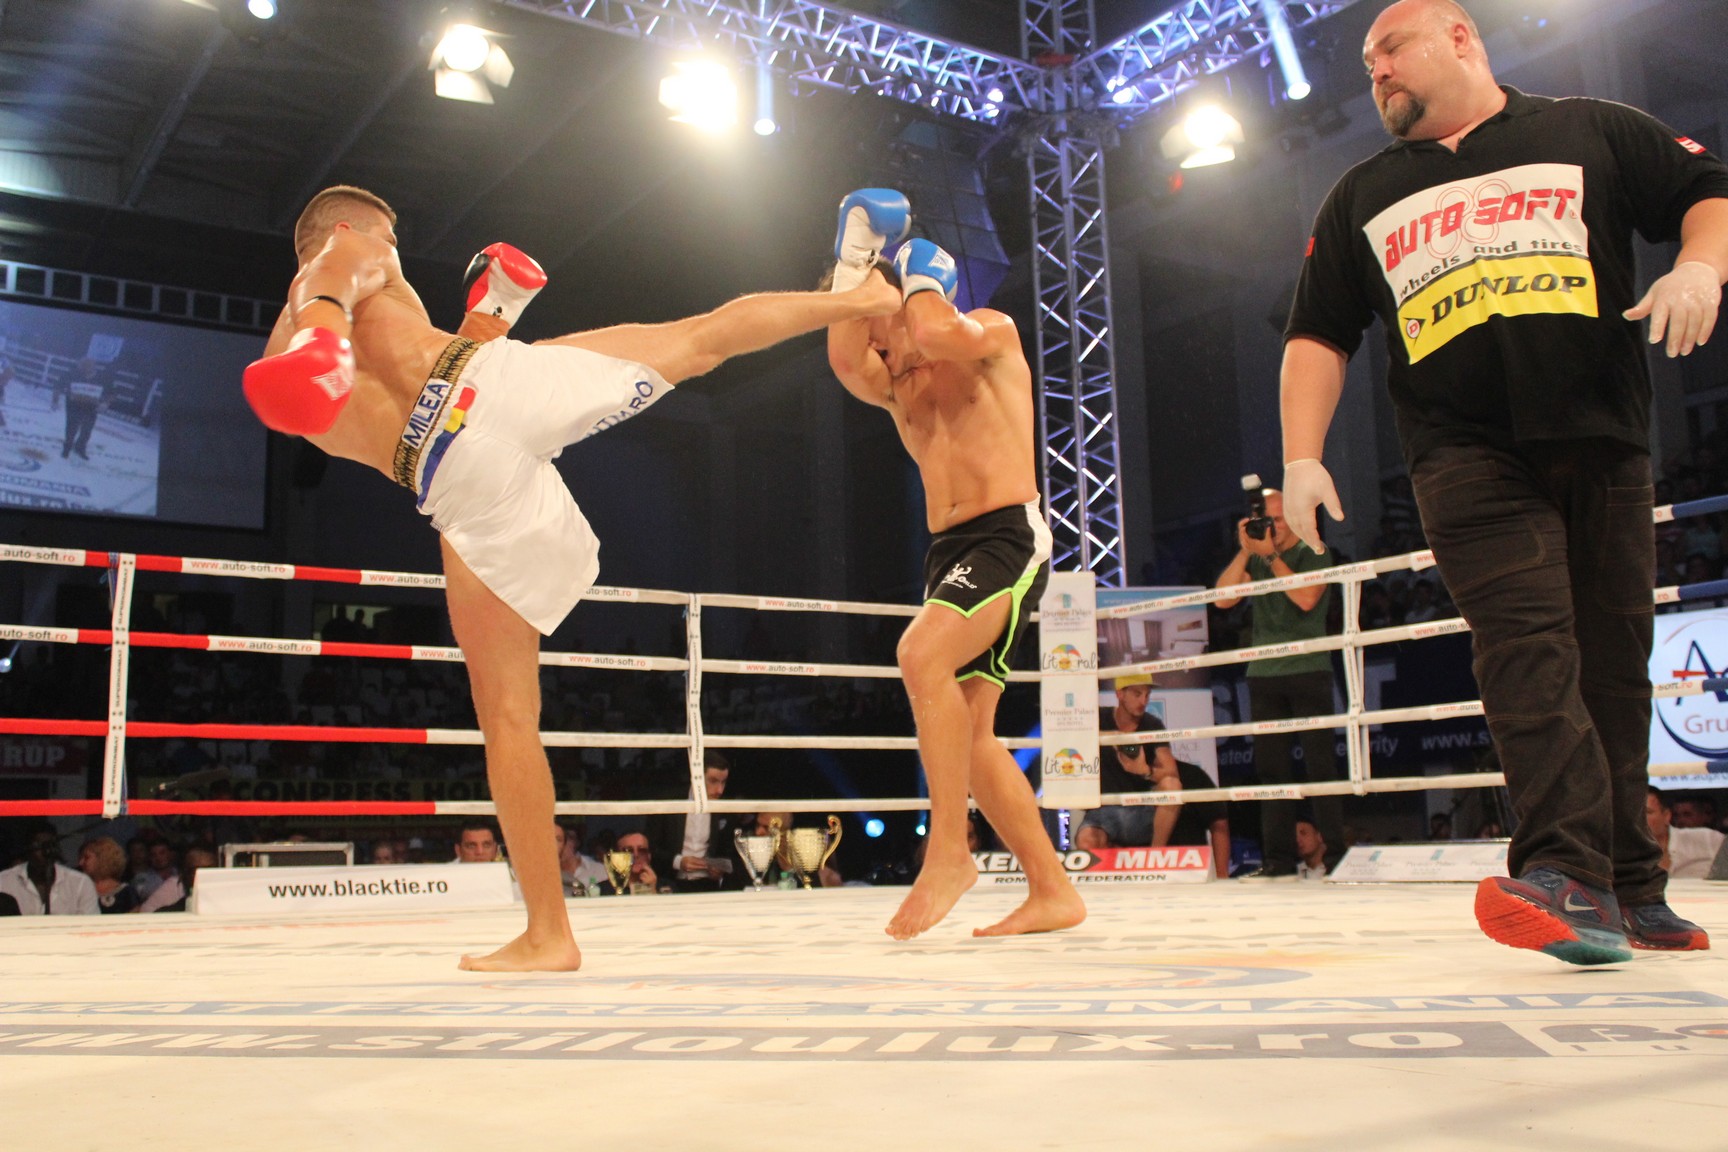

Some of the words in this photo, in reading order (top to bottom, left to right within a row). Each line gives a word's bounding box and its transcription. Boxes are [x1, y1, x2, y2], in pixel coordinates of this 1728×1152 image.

[1385, 202, 1465, 272] AUTO
[1473, 188, 1574, 225] SOFT
[1400, 253, 1461, 300] wheels
[1473, 240, 1519, 256] and
[1530, 238, 1584, 254] tires
[1431, 272, 1587, 326] DUNLOP
[403, 378, 449, 448] MILEA
[3, 549, 76, 563] auto-soft.ro
[191, 559, 286, 574] www.auto-soft.ro
[369, 574, 445, 586] www.auto-soft.
[585, 586, 632, 597] uto-soft.ro
[218, 639, 312, 652] www.auto-soft.ro
[1683, 714, 1728, 734] Gru
[3, 745, 66, 769] RUP
[1114, 850, 1204, 869] MMA
[1077, 874, 1167, 883] FEDERATION
[268, 879, 448, 898] www.blacktie.ro
[866, 994, 1707, 1014] ROMANIA
